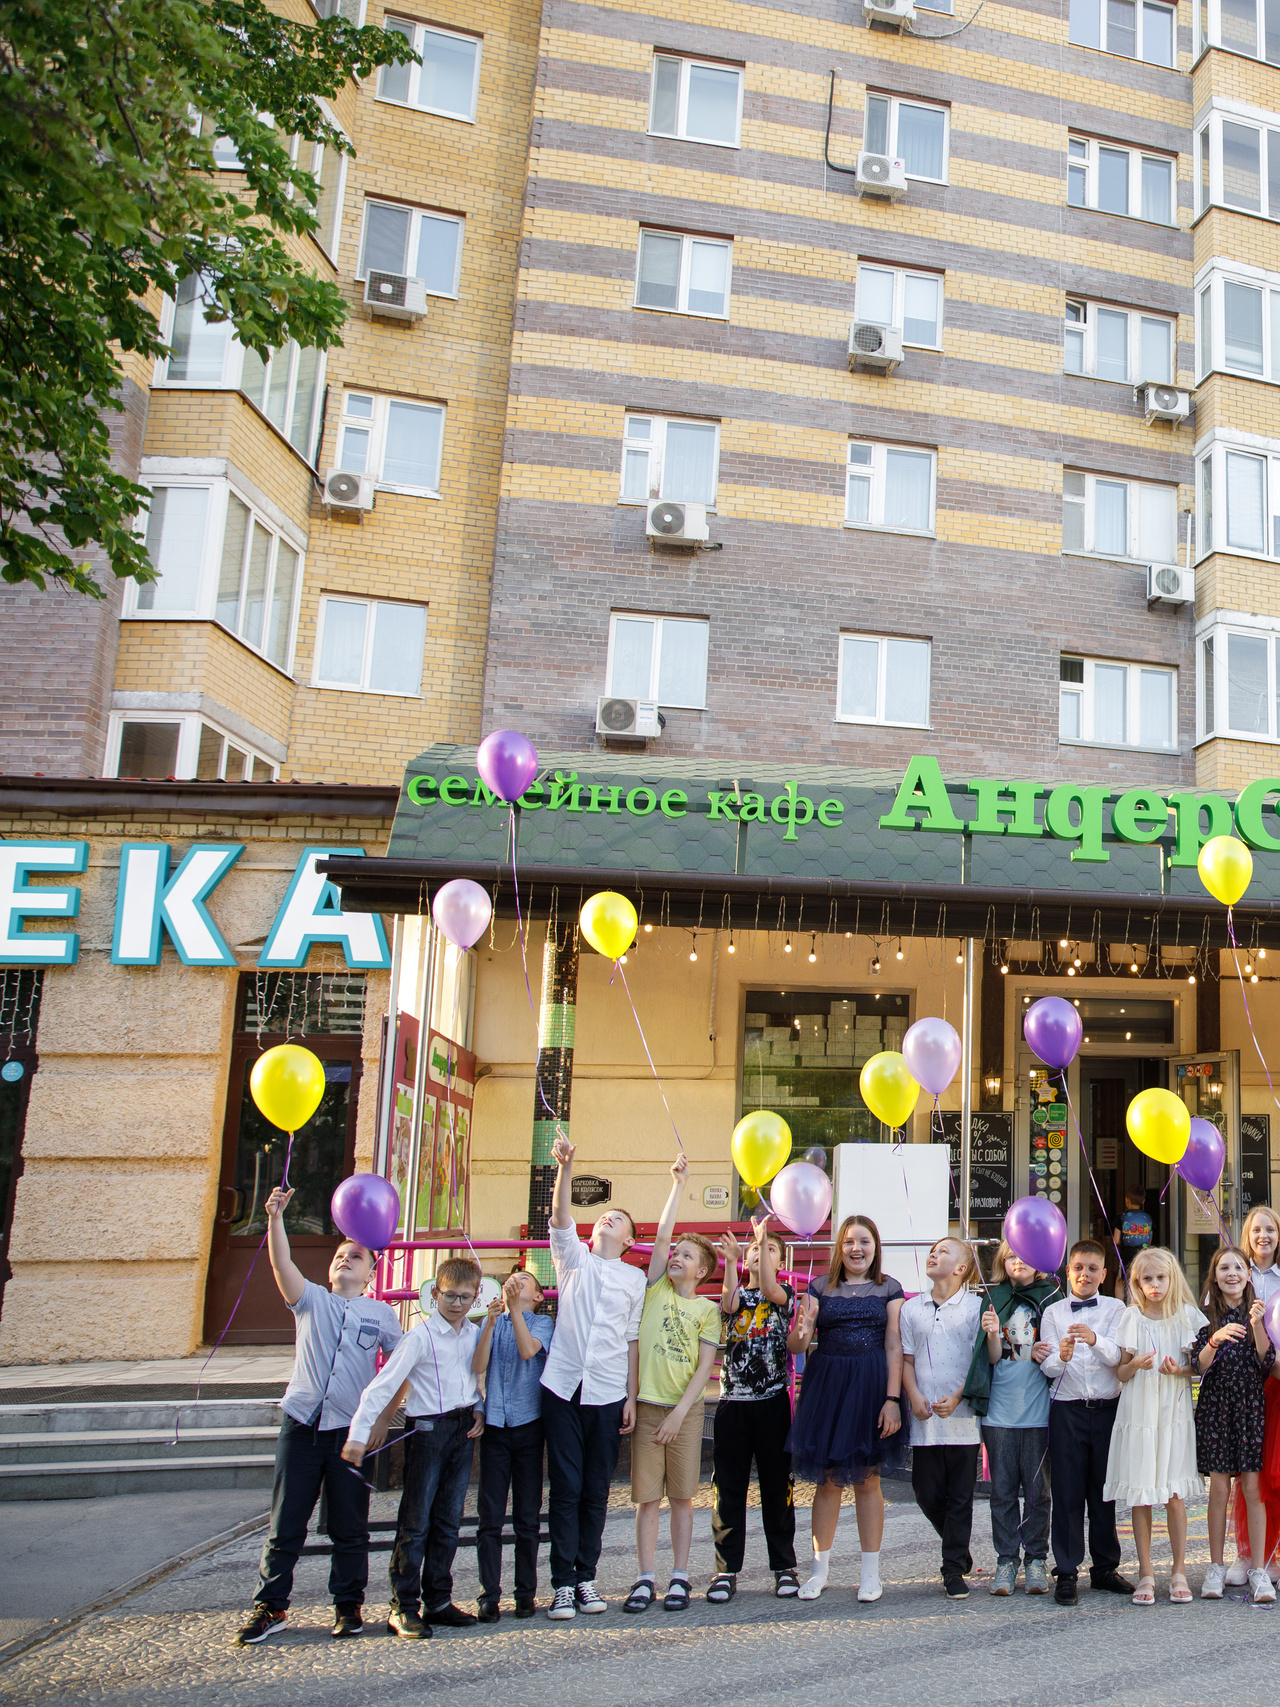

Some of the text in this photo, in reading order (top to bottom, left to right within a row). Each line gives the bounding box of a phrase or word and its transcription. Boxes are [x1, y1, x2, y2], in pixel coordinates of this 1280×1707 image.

[407, 769, 845, 842] семейное кафе
[954, 1117, 990, 1133] СДКА
[984, 1146, 1008, 1162] СОБОЙ
[360, 1317, 381, 1327] UNIQUE
